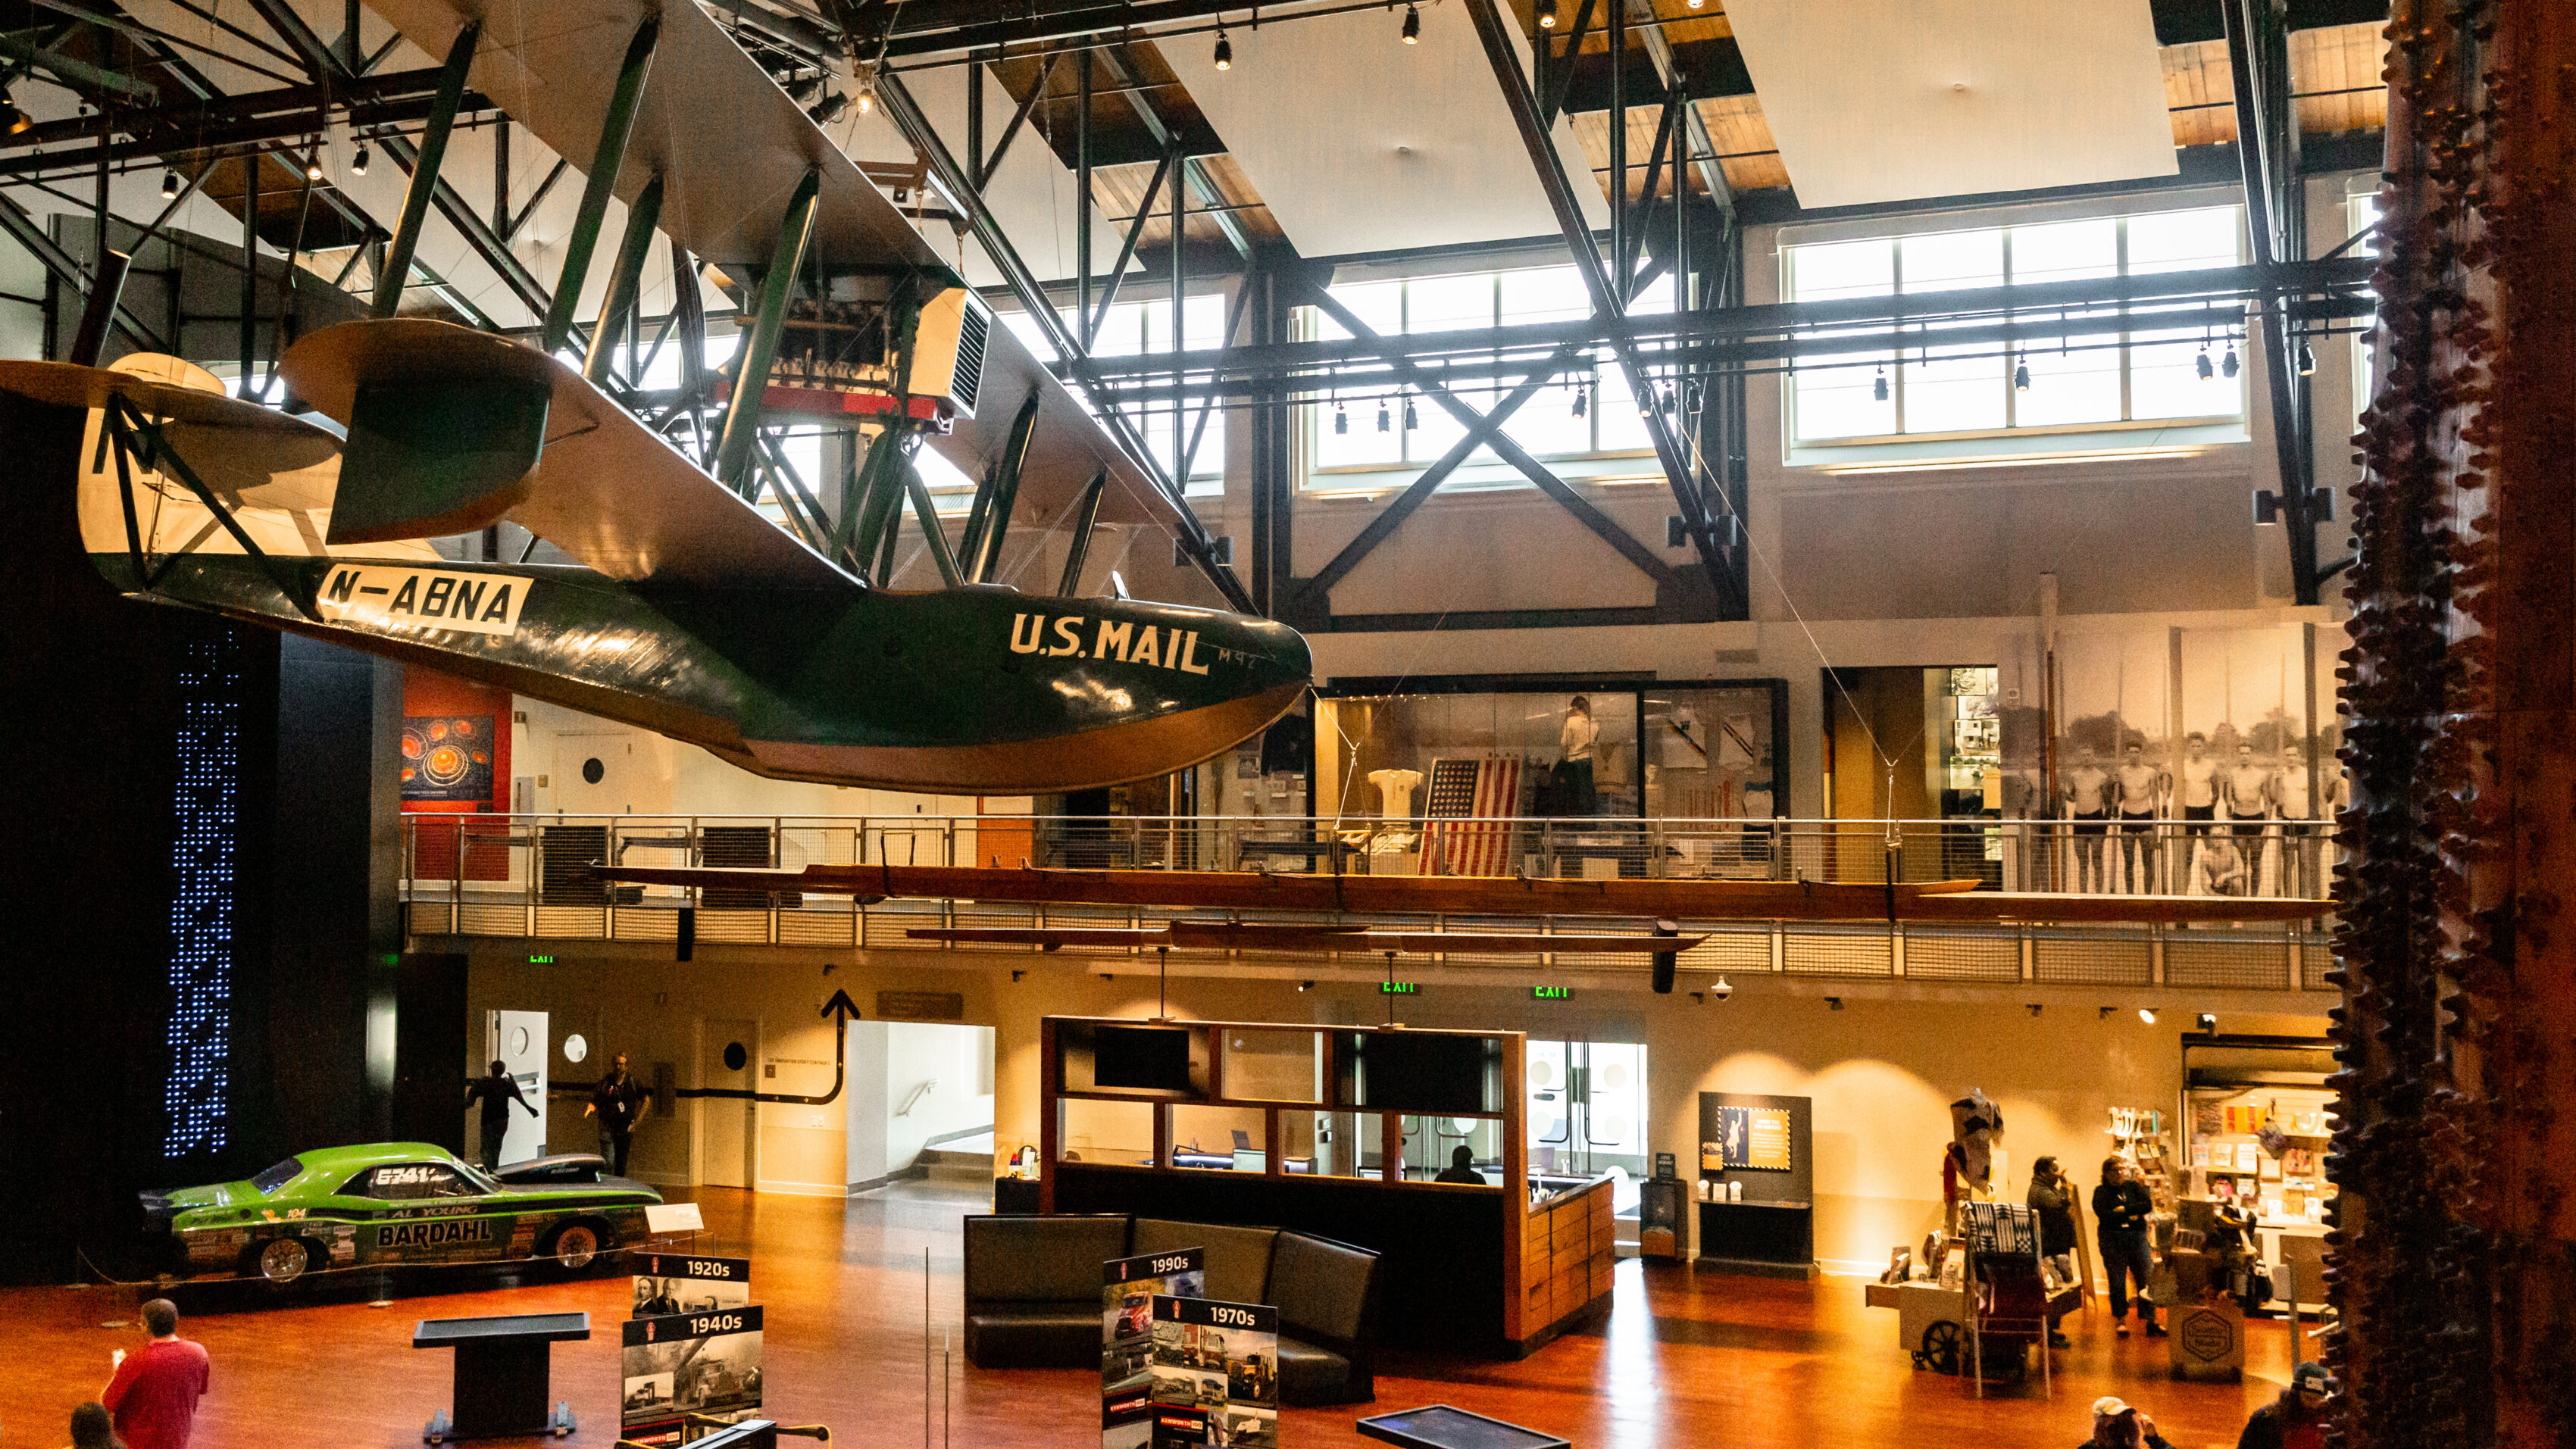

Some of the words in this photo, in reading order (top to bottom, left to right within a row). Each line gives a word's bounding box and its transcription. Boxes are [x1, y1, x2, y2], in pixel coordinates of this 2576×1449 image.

[328, 570, 512, 624] N-ABNA
[287, 1207, 307, 1218] 104
[392, 1210, 413, 1219] AL
[423, 1205, 478, 1216] YOUNG
[377, 1219, 492, 1250] BARDAHL
[687, 1260, 730, 1276] 1920s
[1152, 1256, 1189, 1273] 1990s
[690, 1314, 742, 1334] 1940s
[1211, 1307, 1255, 1326] 1970s
[1161, 1417, 1191, 1426] KENWORTH
[633, 1435, 666, 1444] ENWORTH
